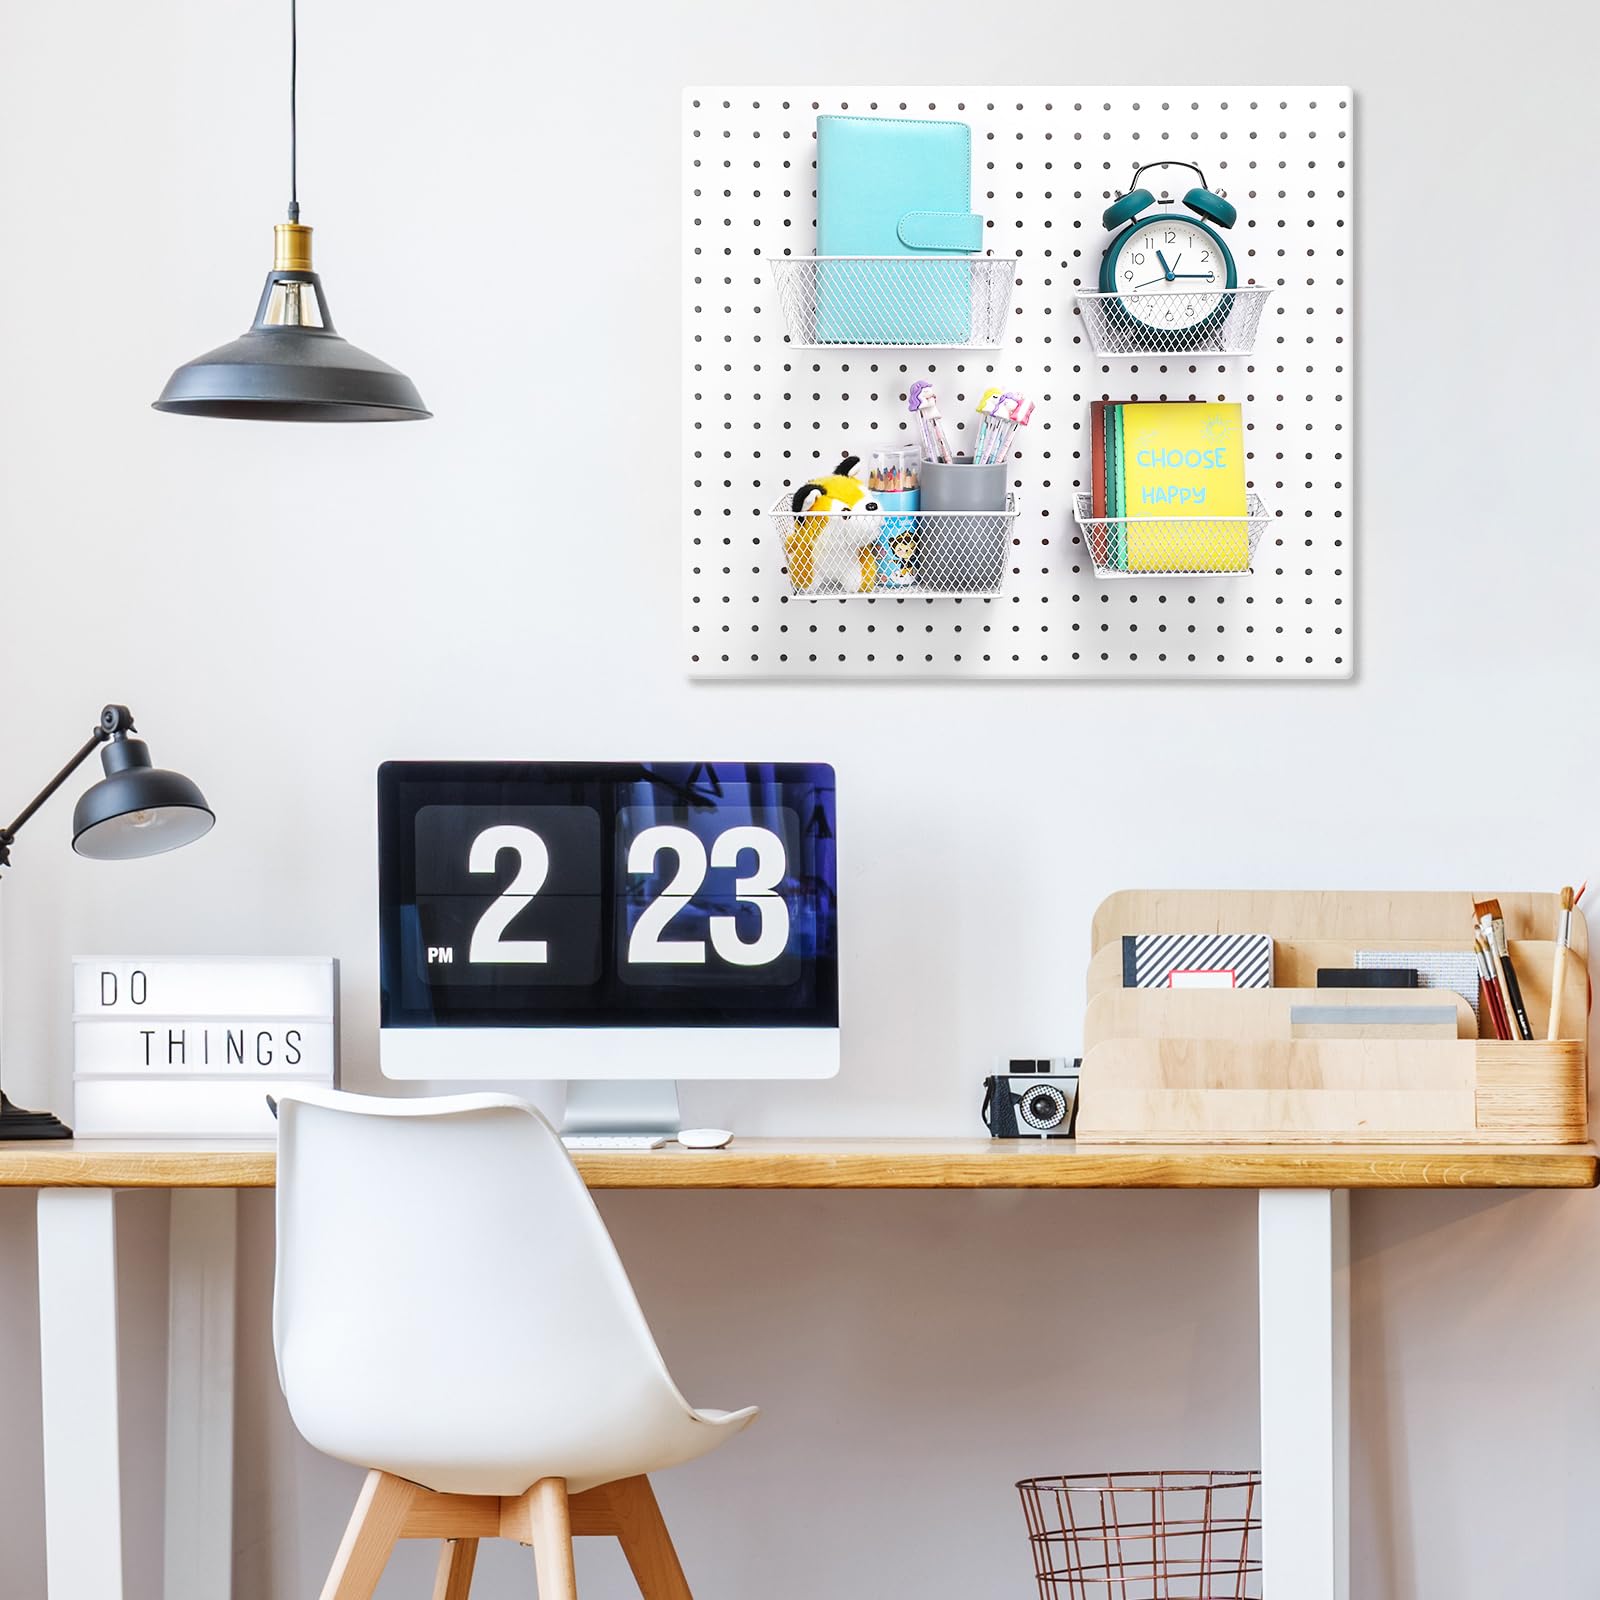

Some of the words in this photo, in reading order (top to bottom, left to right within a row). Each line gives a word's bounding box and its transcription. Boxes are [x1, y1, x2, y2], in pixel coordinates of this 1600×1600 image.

[1145, 237, 1154, 249] 11
[1164, 231, 1177, 244] 12
[1131, 252, 1145, 265] 10
[1200, 250, 1210, 263] 2
[1124, 270, 1134, 282] 9
[1206, 270, 1215, 283] 3
[1164, 309, 1175, 322] 6
[1185, 304, 1195, 317] 5
[1136, 448, 1227, 469] CHOOSE
[1141, 485, 1207, 504] HAPPY
[468, 825, 549, 964] 2
[627, 825, 790, 966] 23
[427, 947, 453, 964] PM
[101, 970, 147, 1006] DO
[140, 1029, 301, 1066] THINGS
